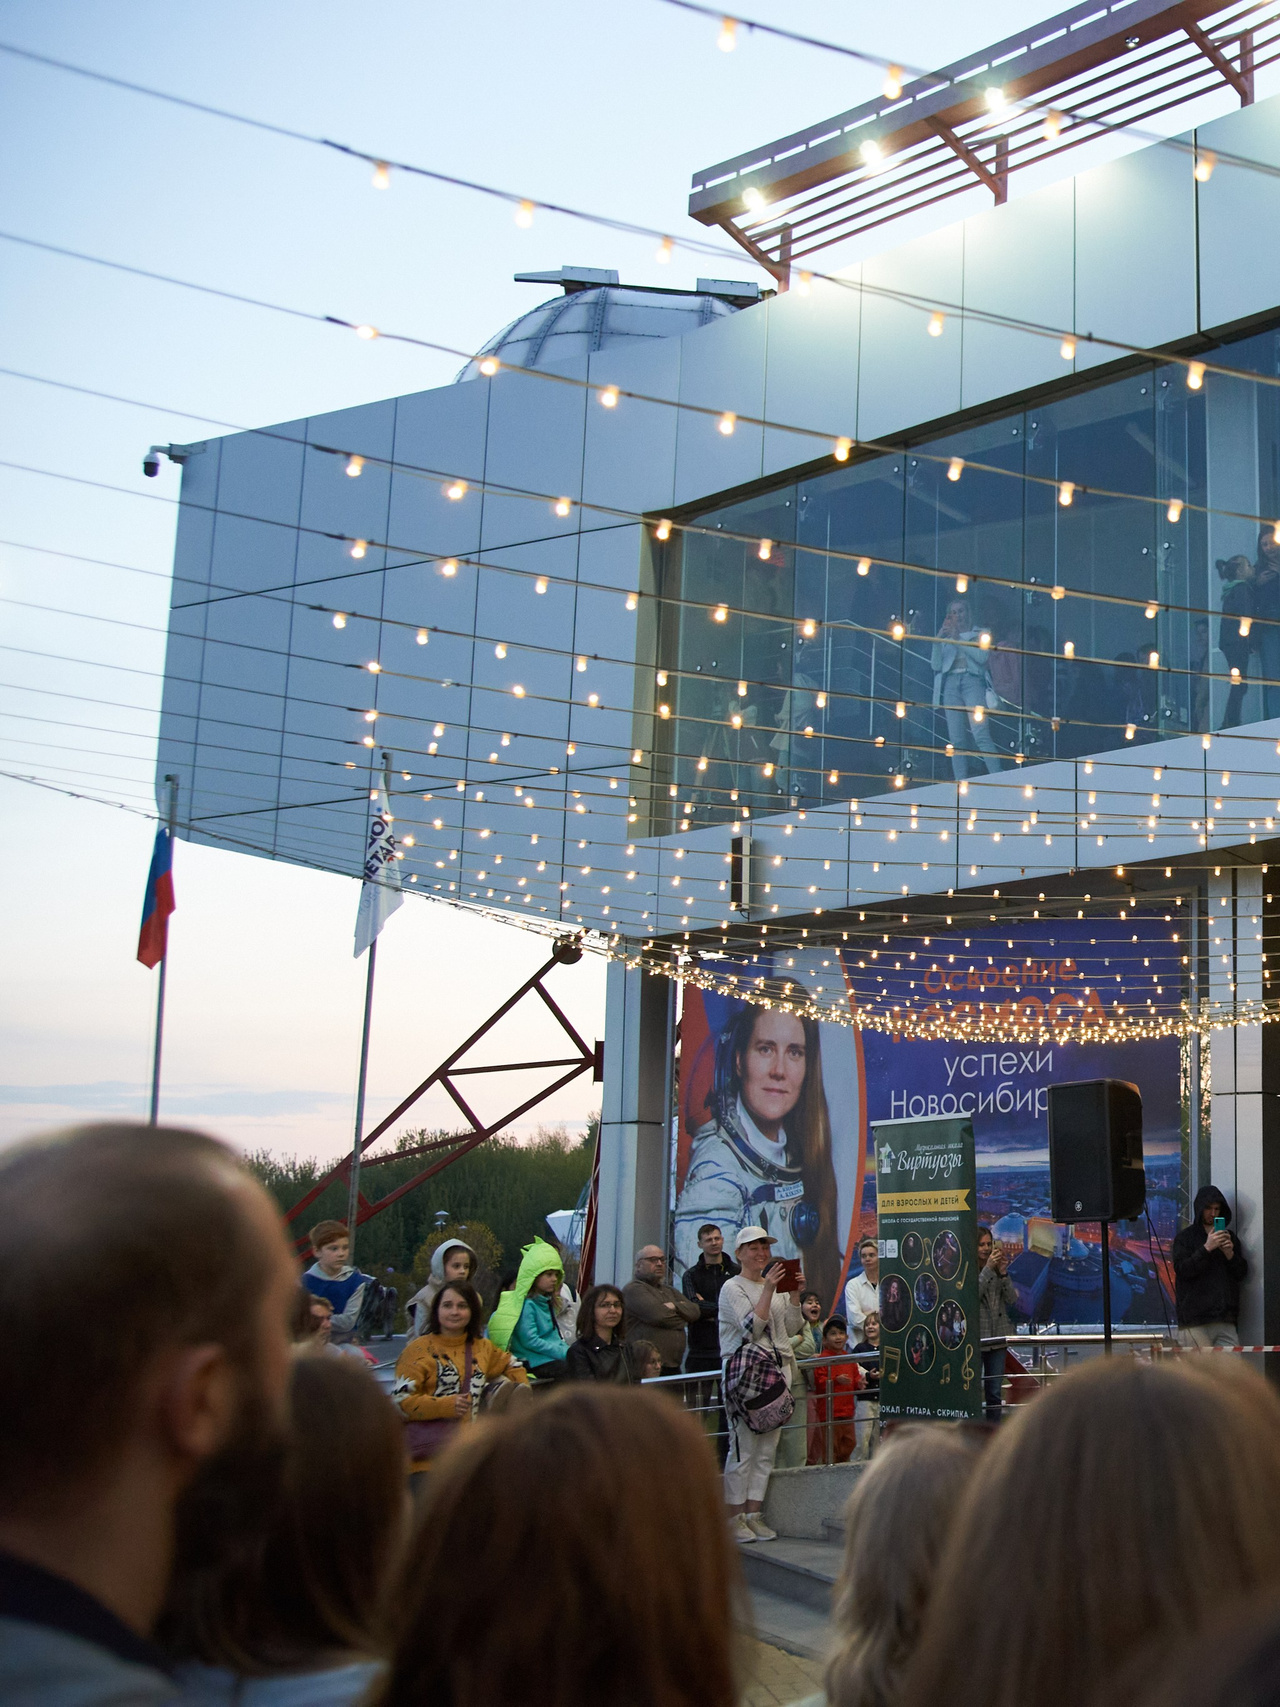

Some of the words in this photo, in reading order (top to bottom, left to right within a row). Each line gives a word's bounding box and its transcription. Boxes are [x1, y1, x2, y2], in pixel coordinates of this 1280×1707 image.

[923, 960, 1077, 994] Освоение
[943, 1050, 1053, 1086] успехи
[890, 1081, 1049, 1119] Новосибир
[897, 1150, 964, 1180] Виртуозы
[881, 1199, 894, 1208] ДЛЯ
[896, 1198, 932, 1207] ВЗРОСЛЫХ
[934, 1197, 939, 1205] И
[940, 1195, 959, 1206] ДЕТЕЙ
[906, 1406, 931, 1416] ГИТАРА
[936, 1408, 969, 1418] СКРИПКА
